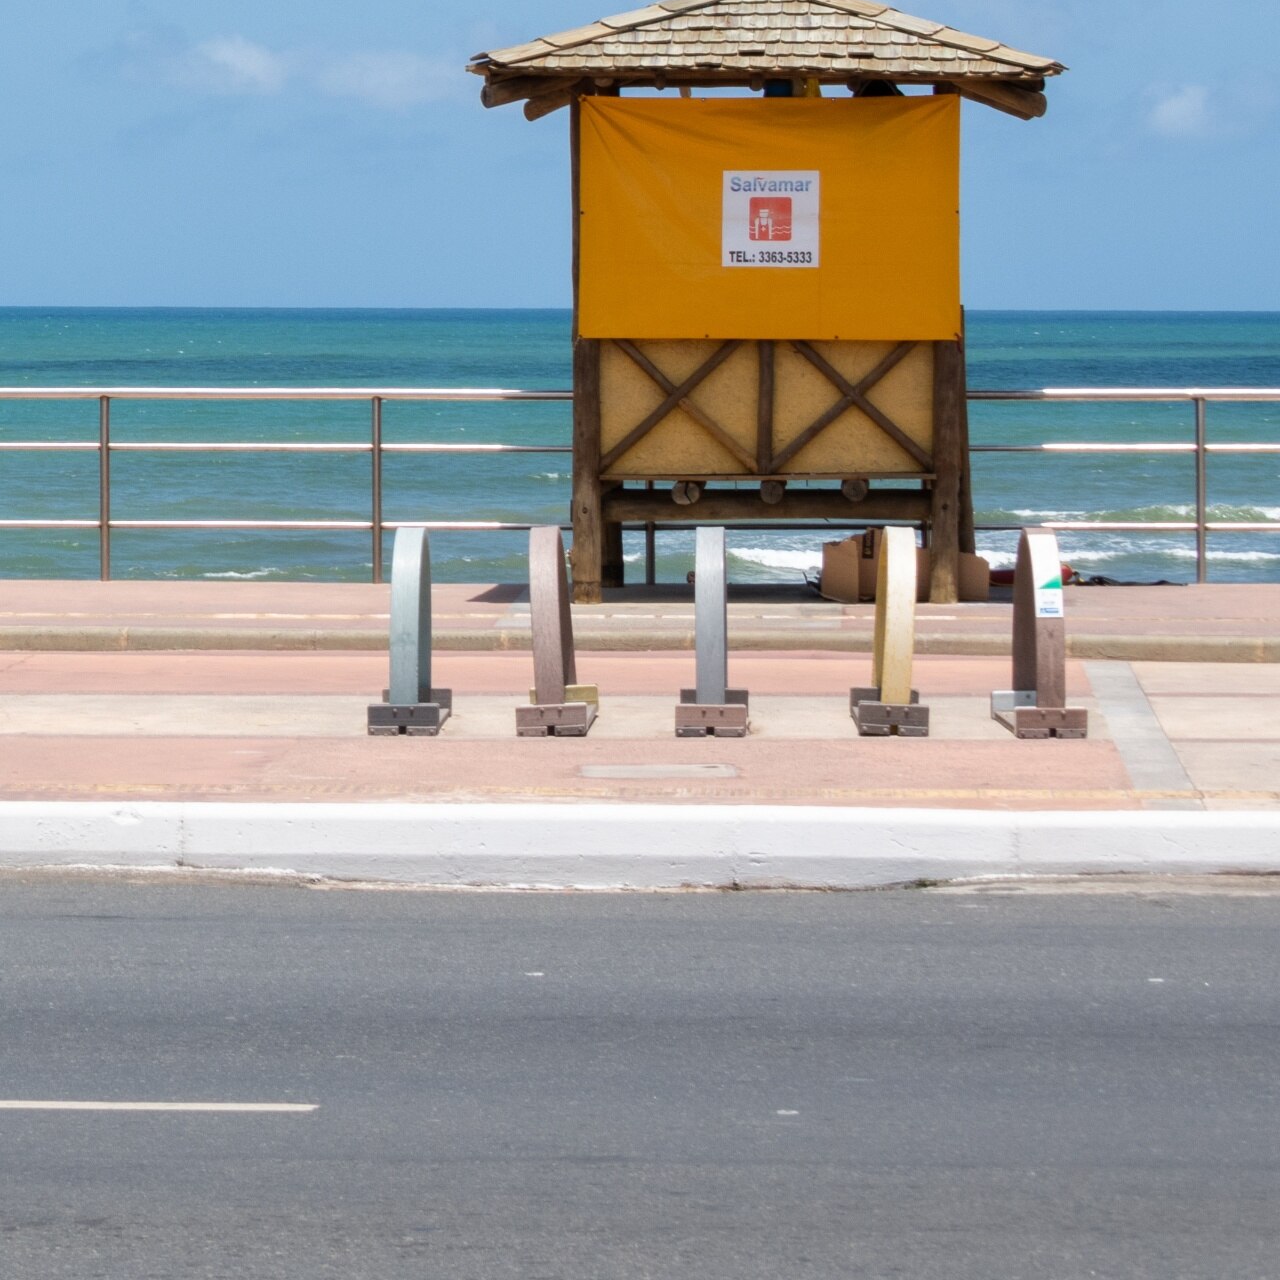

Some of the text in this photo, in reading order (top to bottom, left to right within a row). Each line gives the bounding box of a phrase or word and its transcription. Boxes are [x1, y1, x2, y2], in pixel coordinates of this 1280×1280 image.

[730, 176, 812, 192] Salvamar
[729, 251, 812, 264] TEL.: 3363-5333
